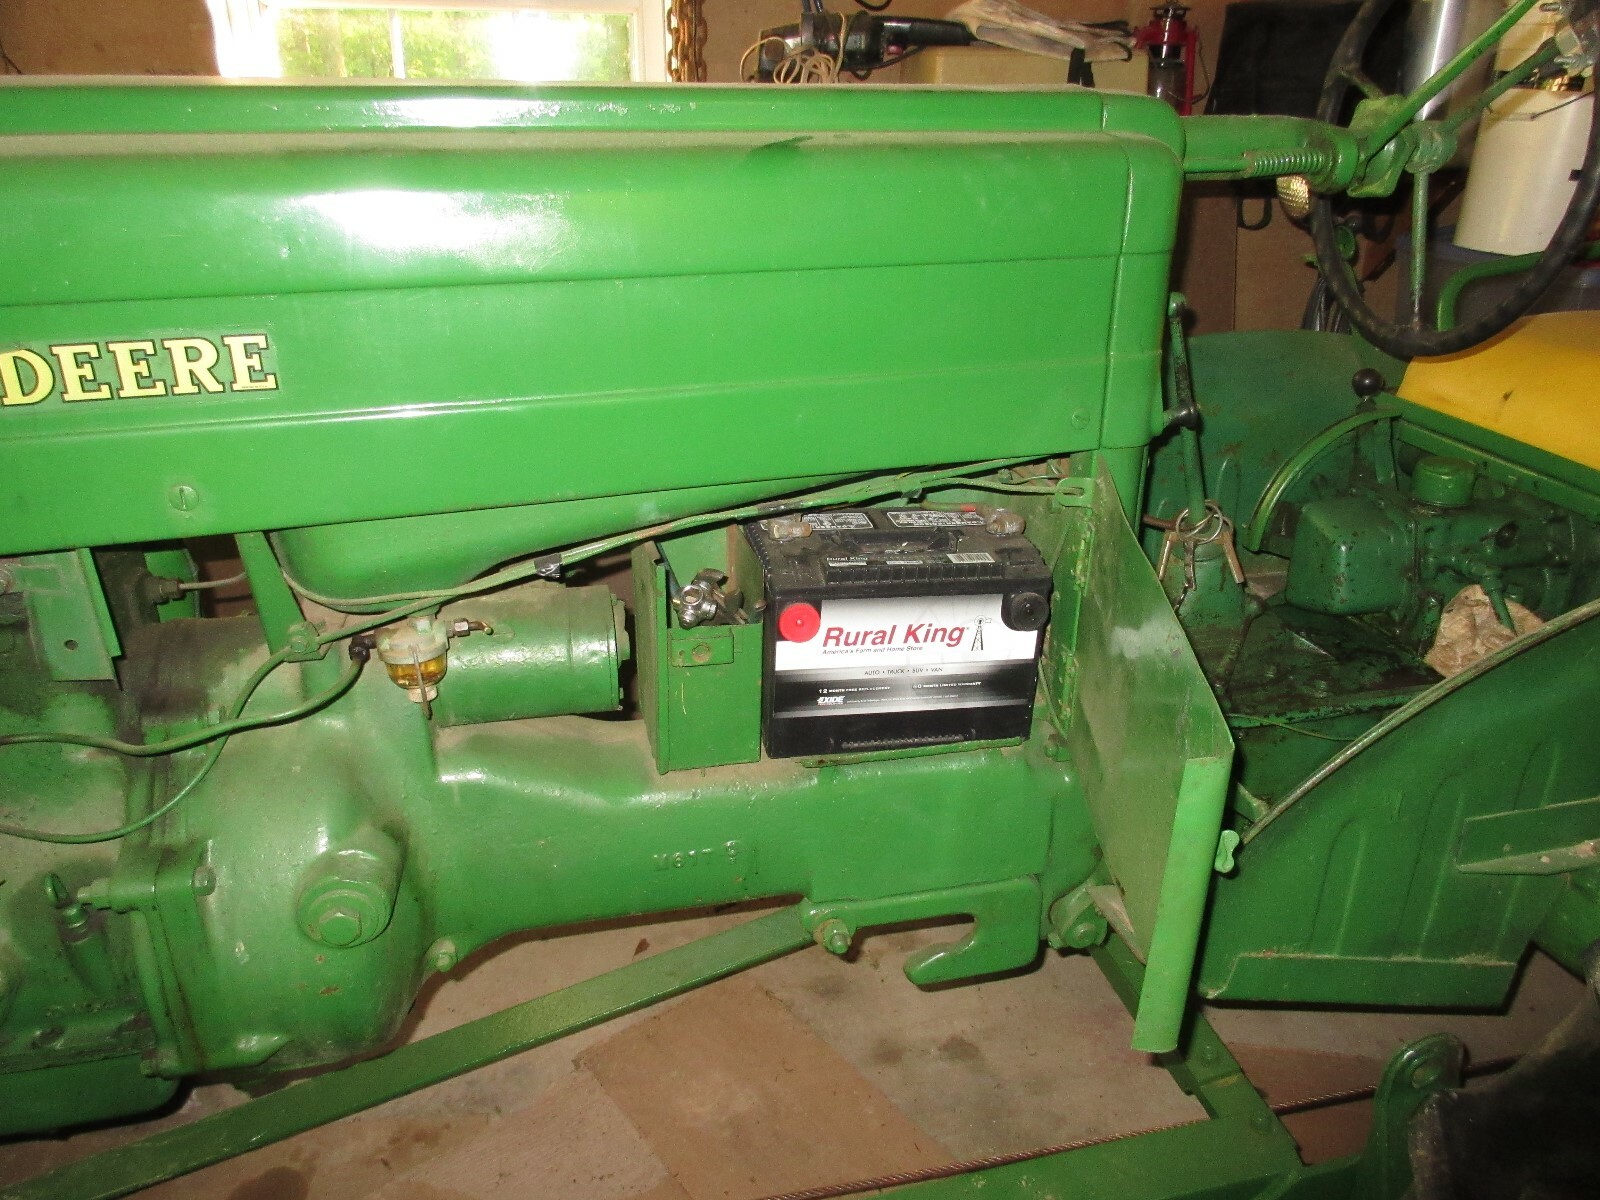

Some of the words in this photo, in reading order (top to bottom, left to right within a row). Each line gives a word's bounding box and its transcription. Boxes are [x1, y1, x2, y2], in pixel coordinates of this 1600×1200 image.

[0, 333, 279, 407] DEERE
[822, 624, 898, 647] Rural
[903, 623, 965, 648] King
